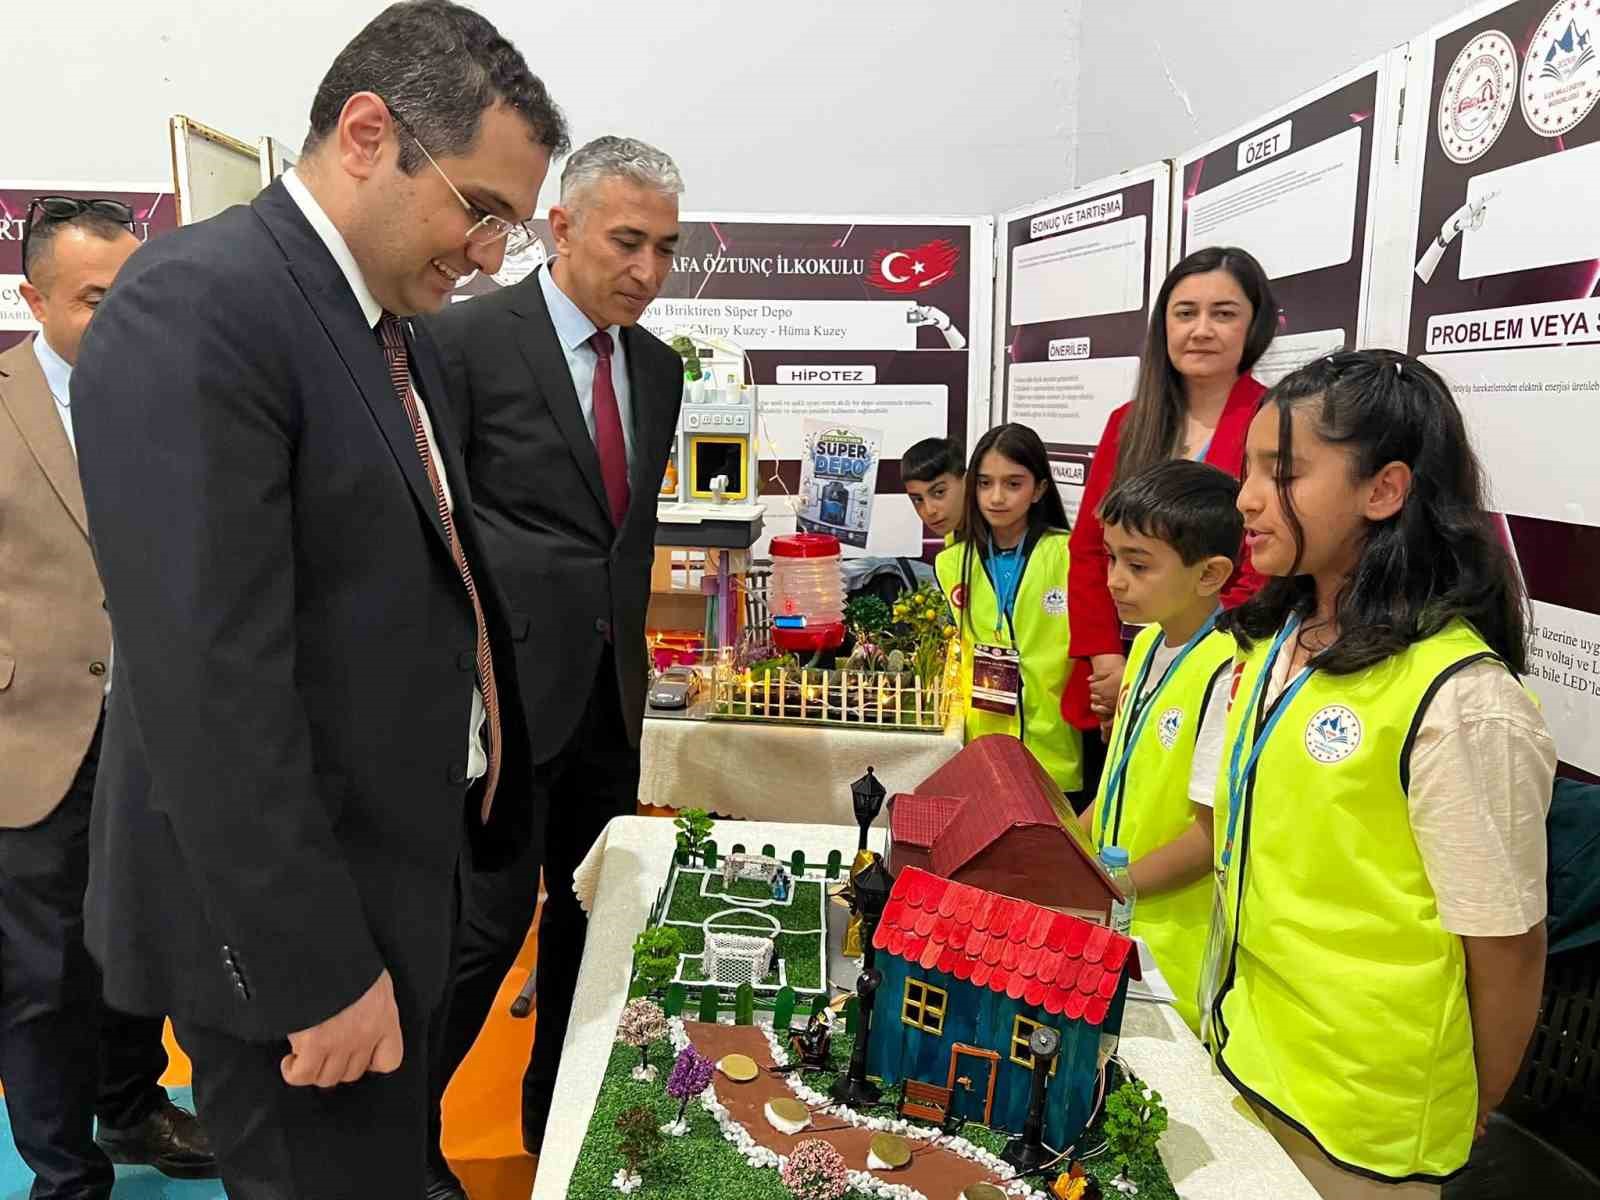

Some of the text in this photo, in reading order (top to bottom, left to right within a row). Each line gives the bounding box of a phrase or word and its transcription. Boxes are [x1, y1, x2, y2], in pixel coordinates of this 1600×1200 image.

[1246, 134, 1280, 164] ÖZET
[1032, 199, 1121, 234] SONUÇ VE TARTIŞMA
[703, 253, 773, 278] ÖZTUNÇ
[777, 254, 864, 275] İLKOKULU
[665, 304, 721, 317] Biriktiren
[724, 304, 758, 320] Süper
[762, 305, 793, 320] Depo
[733, 324, 768, 338] Kuzey
[778, 325, 810, 336] Hüma
[814, 325, 848, 339] Kuzey
[1431, 318, 1524, 346] PROBLEM
[1531, 312, 1589, 337] VEYA
[1050, 343, 1089, 357] ÖNERİLER
[791, 368, 863, 381] HİPOTEZ
[815, 456, 865, 475] DEPO
[1542, 626, 1578, 647] üzerine
[1546, 650, 1574, 670] voltaj
[1577, 659, 1589, 672] ve
[1542, 666, 1560, 683] bile
